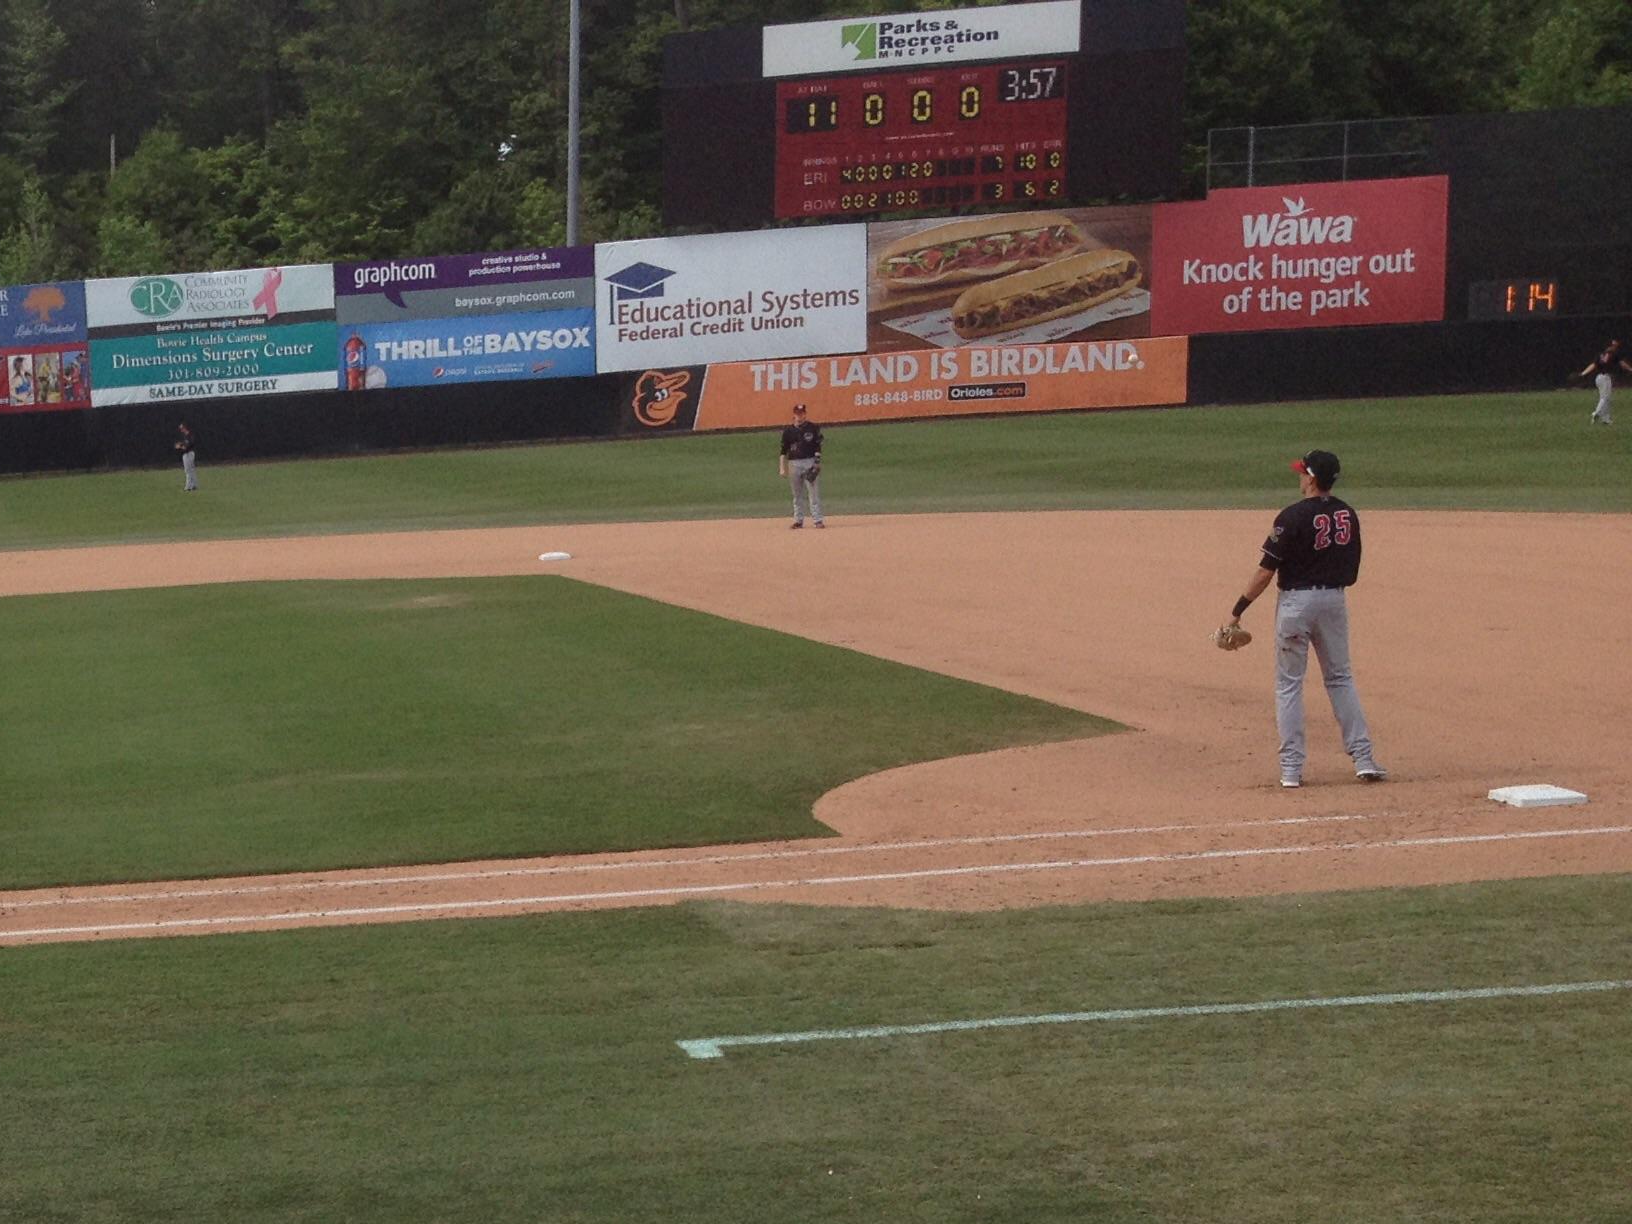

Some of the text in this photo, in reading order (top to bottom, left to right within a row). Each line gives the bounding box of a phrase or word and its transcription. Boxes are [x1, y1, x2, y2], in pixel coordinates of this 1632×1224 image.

[878, 19, 959, 35] Parks &
[878, 29, 999, 50] Recreation
[1004, 69, 1057, 101] 3:57
[808, 100, 837, 128] 11
[865, 94, 883, 126] 0
[912, 90, 931, 122] 0
[961, 86, 979, 118] 0
[1242, 214, 1354, 249] Wawa
[354, 261, 436, 289] graphcom
[1183, 247, 1416, 286] Knock hunger out
[186, 301, 250, 313] ASSOCIATES
[454, 288, 576, 307] baysox.graphcom.com
[617, 287, 860, 326] Educational Systems
[1223, 281, 1371, 316] of the park
[157, 332, 267, 348] Bowie Health Campus
[374, 337, 463, 361] THRILL
[464, 336, 483, 348] OF
[484, 326, 591, 355] BAYSOX
[617, 315, 805, 343] Federal Credit Union
[112, 341, 314, 370] Dimensions Surgery Center
[217, 379, 279, 394] SURGERY
[750, 360, 818, 391] THIS
[828, 356, 918, 387] LAND
[930, 352, 958, 379] IS
[950, 385, 1024, 400] Orioles.com
[1313, 510, 1352, 552] 25
